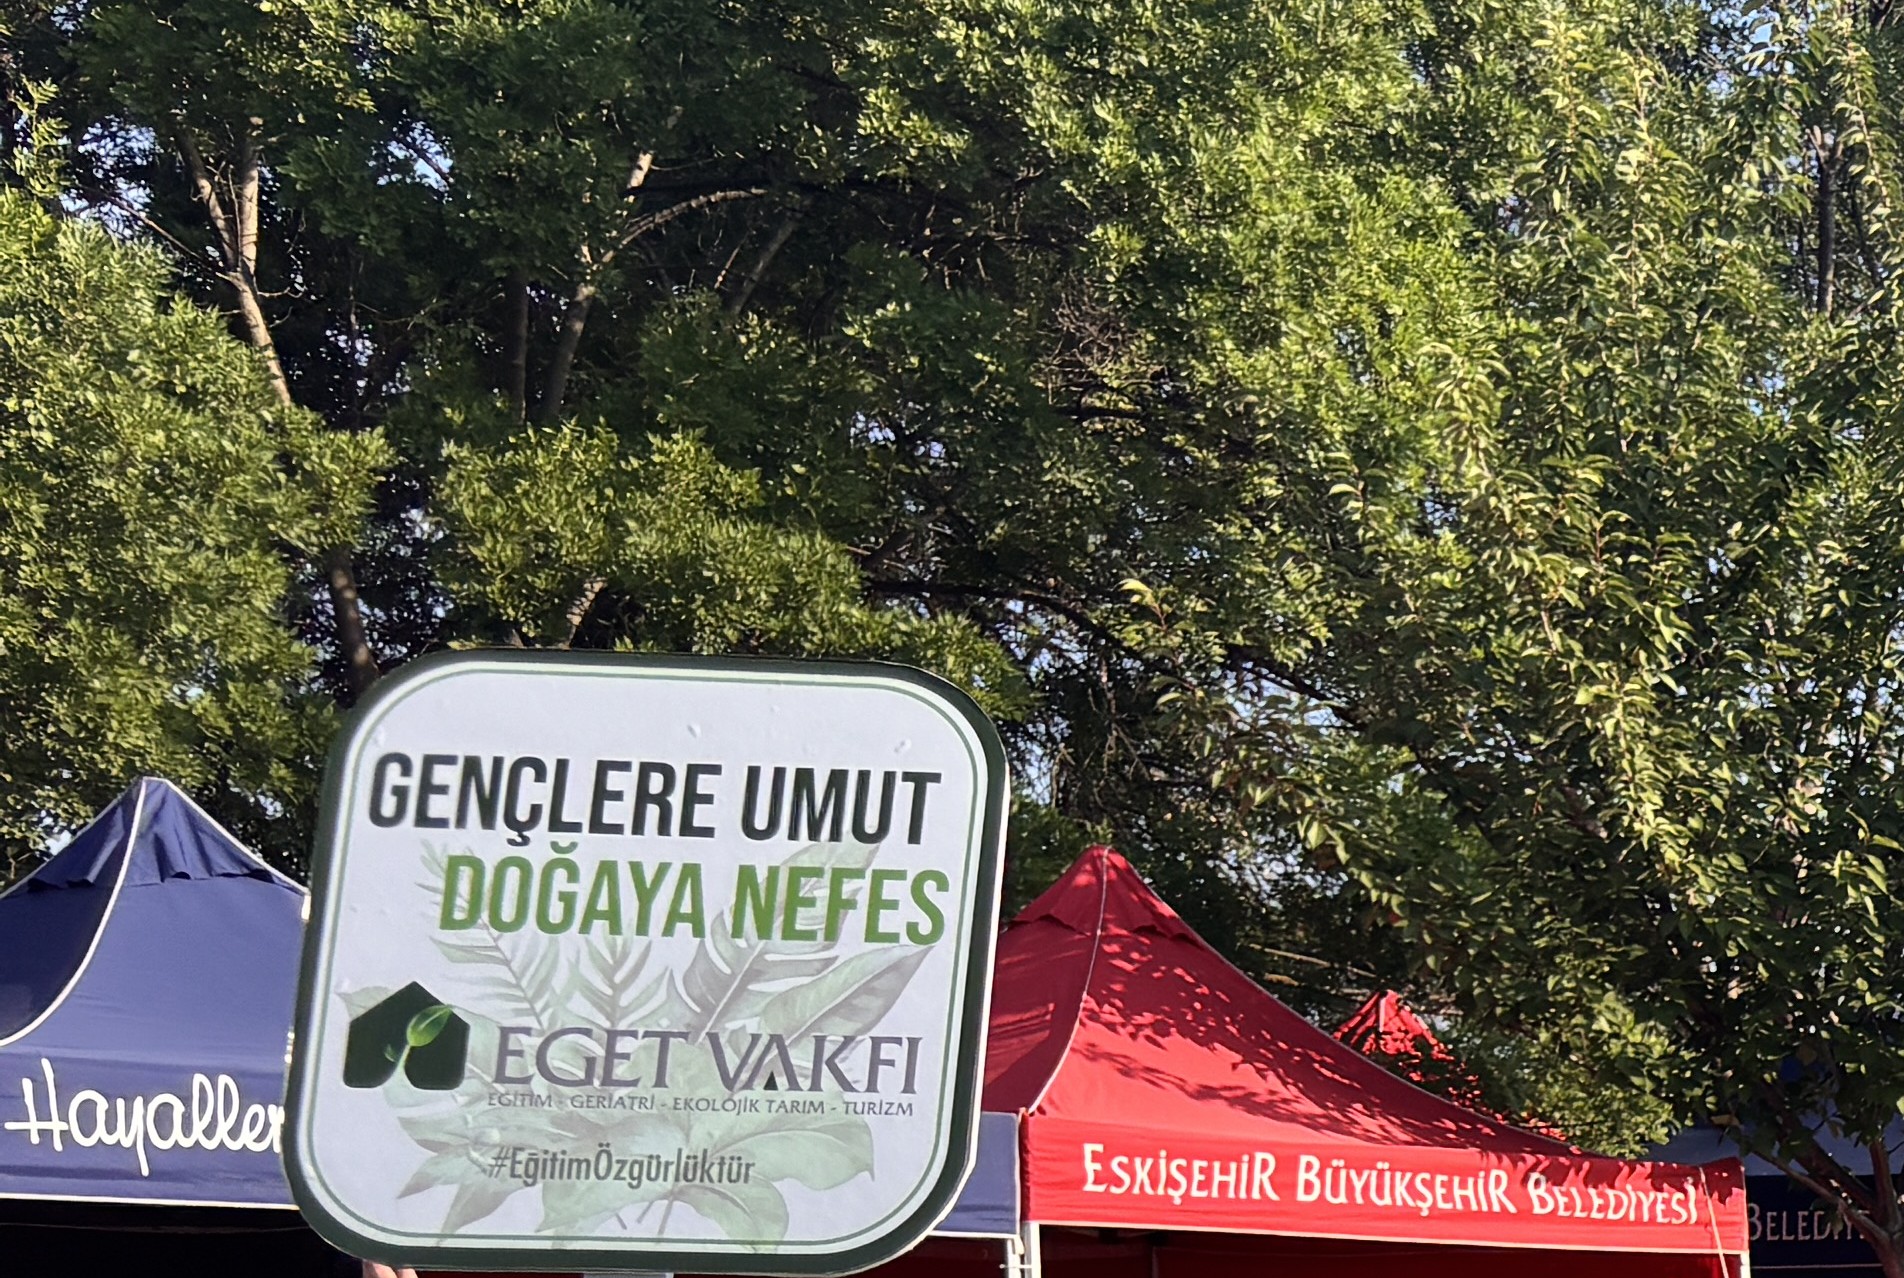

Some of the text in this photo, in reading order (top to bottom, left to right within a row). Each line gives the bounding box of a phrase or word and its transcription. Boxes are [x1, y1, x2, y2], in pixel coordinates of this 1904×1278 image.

[369, 752, 941, 846] GENÇLERE UMUT
[440, 840, 950, 944] DOĞAYA NEFES
[494, 1026, 922, 1095] EGET VAKFI
[766, 1100, 825, 1115] TARIM
